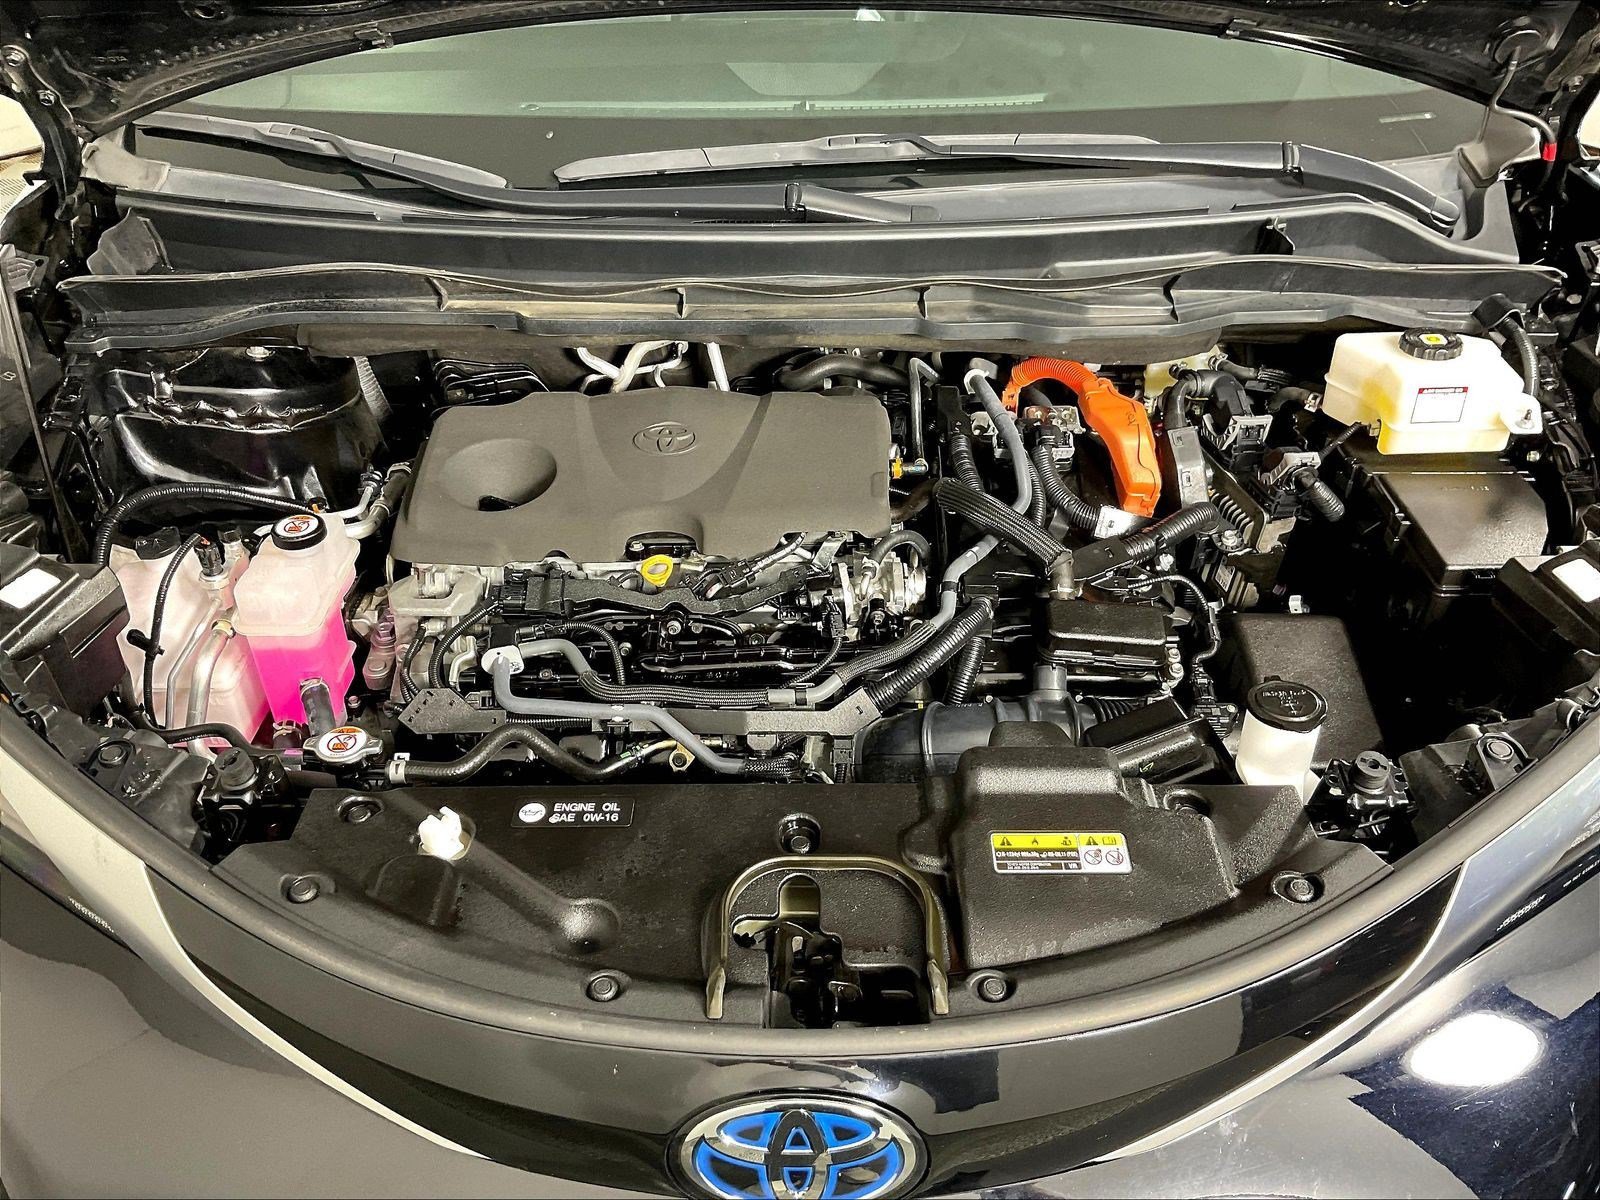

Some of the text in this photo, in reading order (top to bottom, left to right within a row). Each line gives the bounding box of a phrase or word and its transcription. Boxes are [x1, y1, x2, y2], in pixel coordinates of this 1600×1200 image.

[553, 802, 596, 812] ENGINE
[602, 802, 621, 812] OIL
[552, 812, 576, 822] SAE
[583, 812, 619, 822] 0W-16
